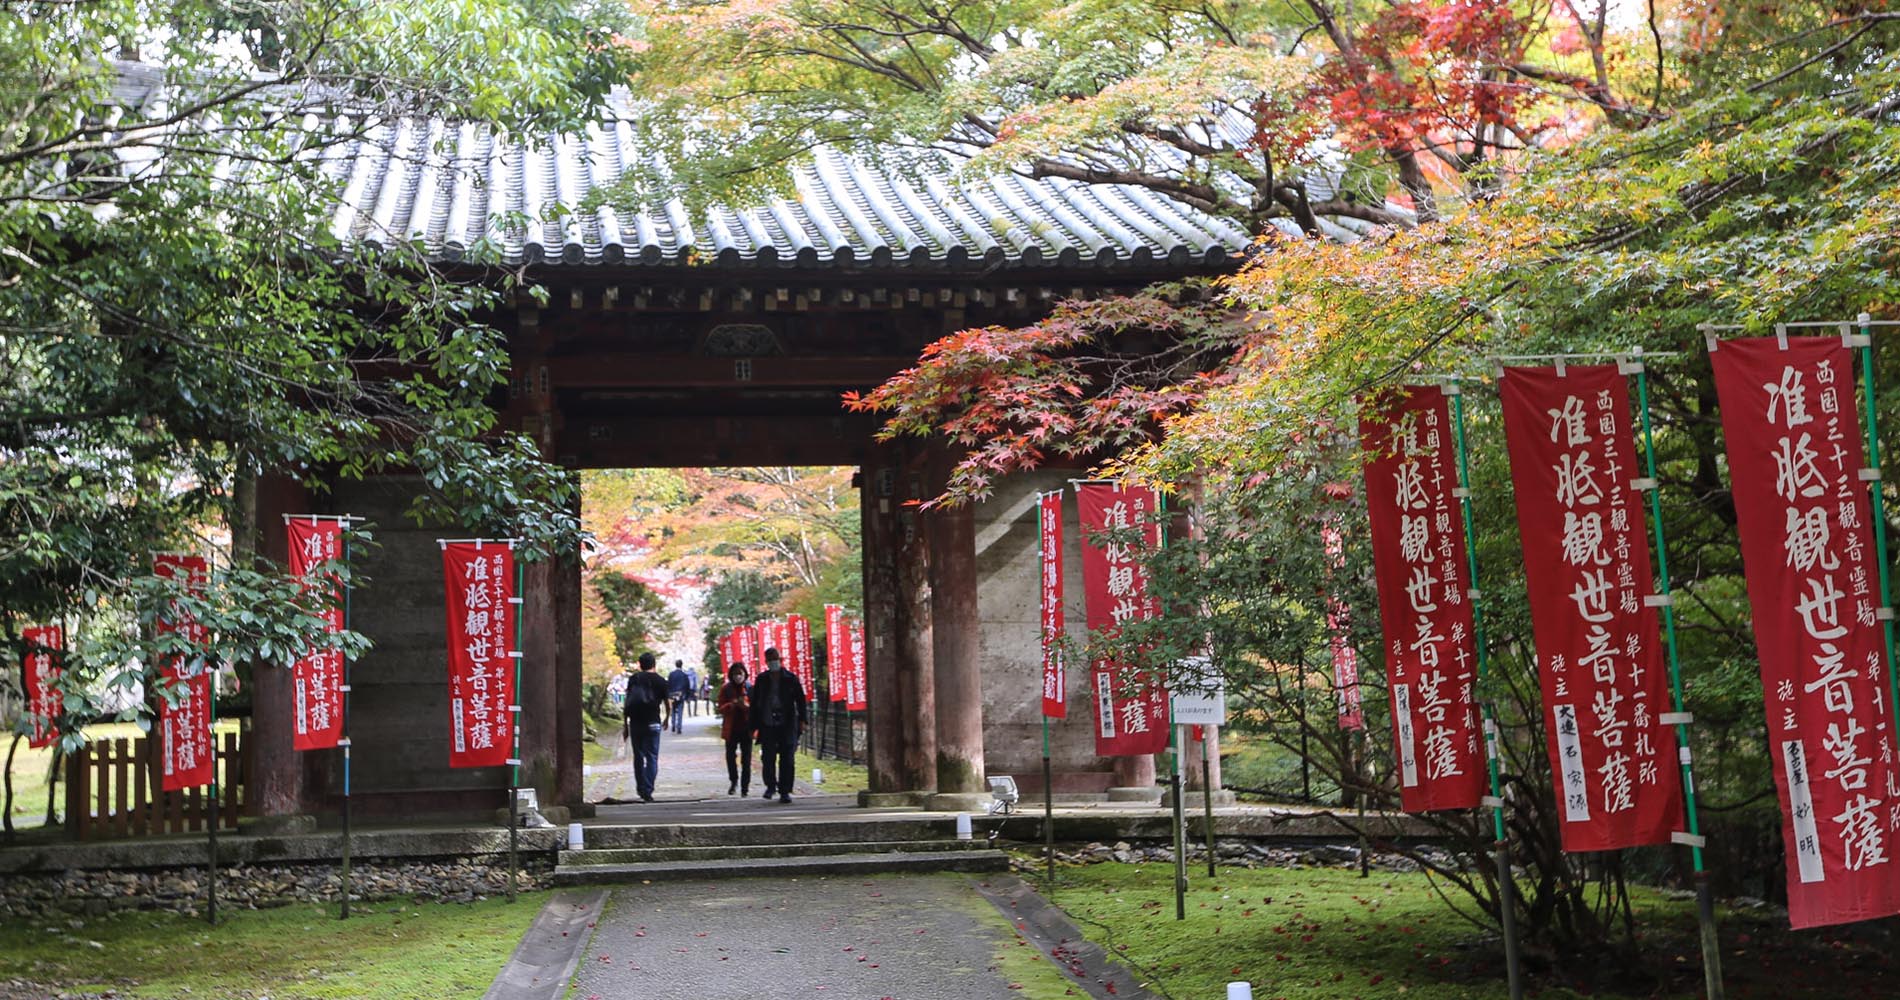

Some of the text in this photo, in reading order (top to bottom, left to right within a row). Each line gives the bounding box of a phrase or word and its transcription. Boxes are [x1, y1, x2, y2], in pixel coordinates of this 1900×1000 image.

[1389, 411, 1464, 780] 准胝観世音菩薩
[1425, 408, 1461, 605] 西国三十三観音霊場
[1548, 394, 1635, 814] 准胝観世音菩薩
[1597, 390, 1658, 785] 西国三十三観音霊場 第十一番札所
[1763, 365, 1889, 871] 准胝観世音菩薩
[1817, 359, 1877, 627] 西国三十三観音霊場
[465, 556, 494, 749] 准胝観世音菩薩
[1551, 653, 1569, 697] 施主
[1777, 678, 1799, 731] 施主
